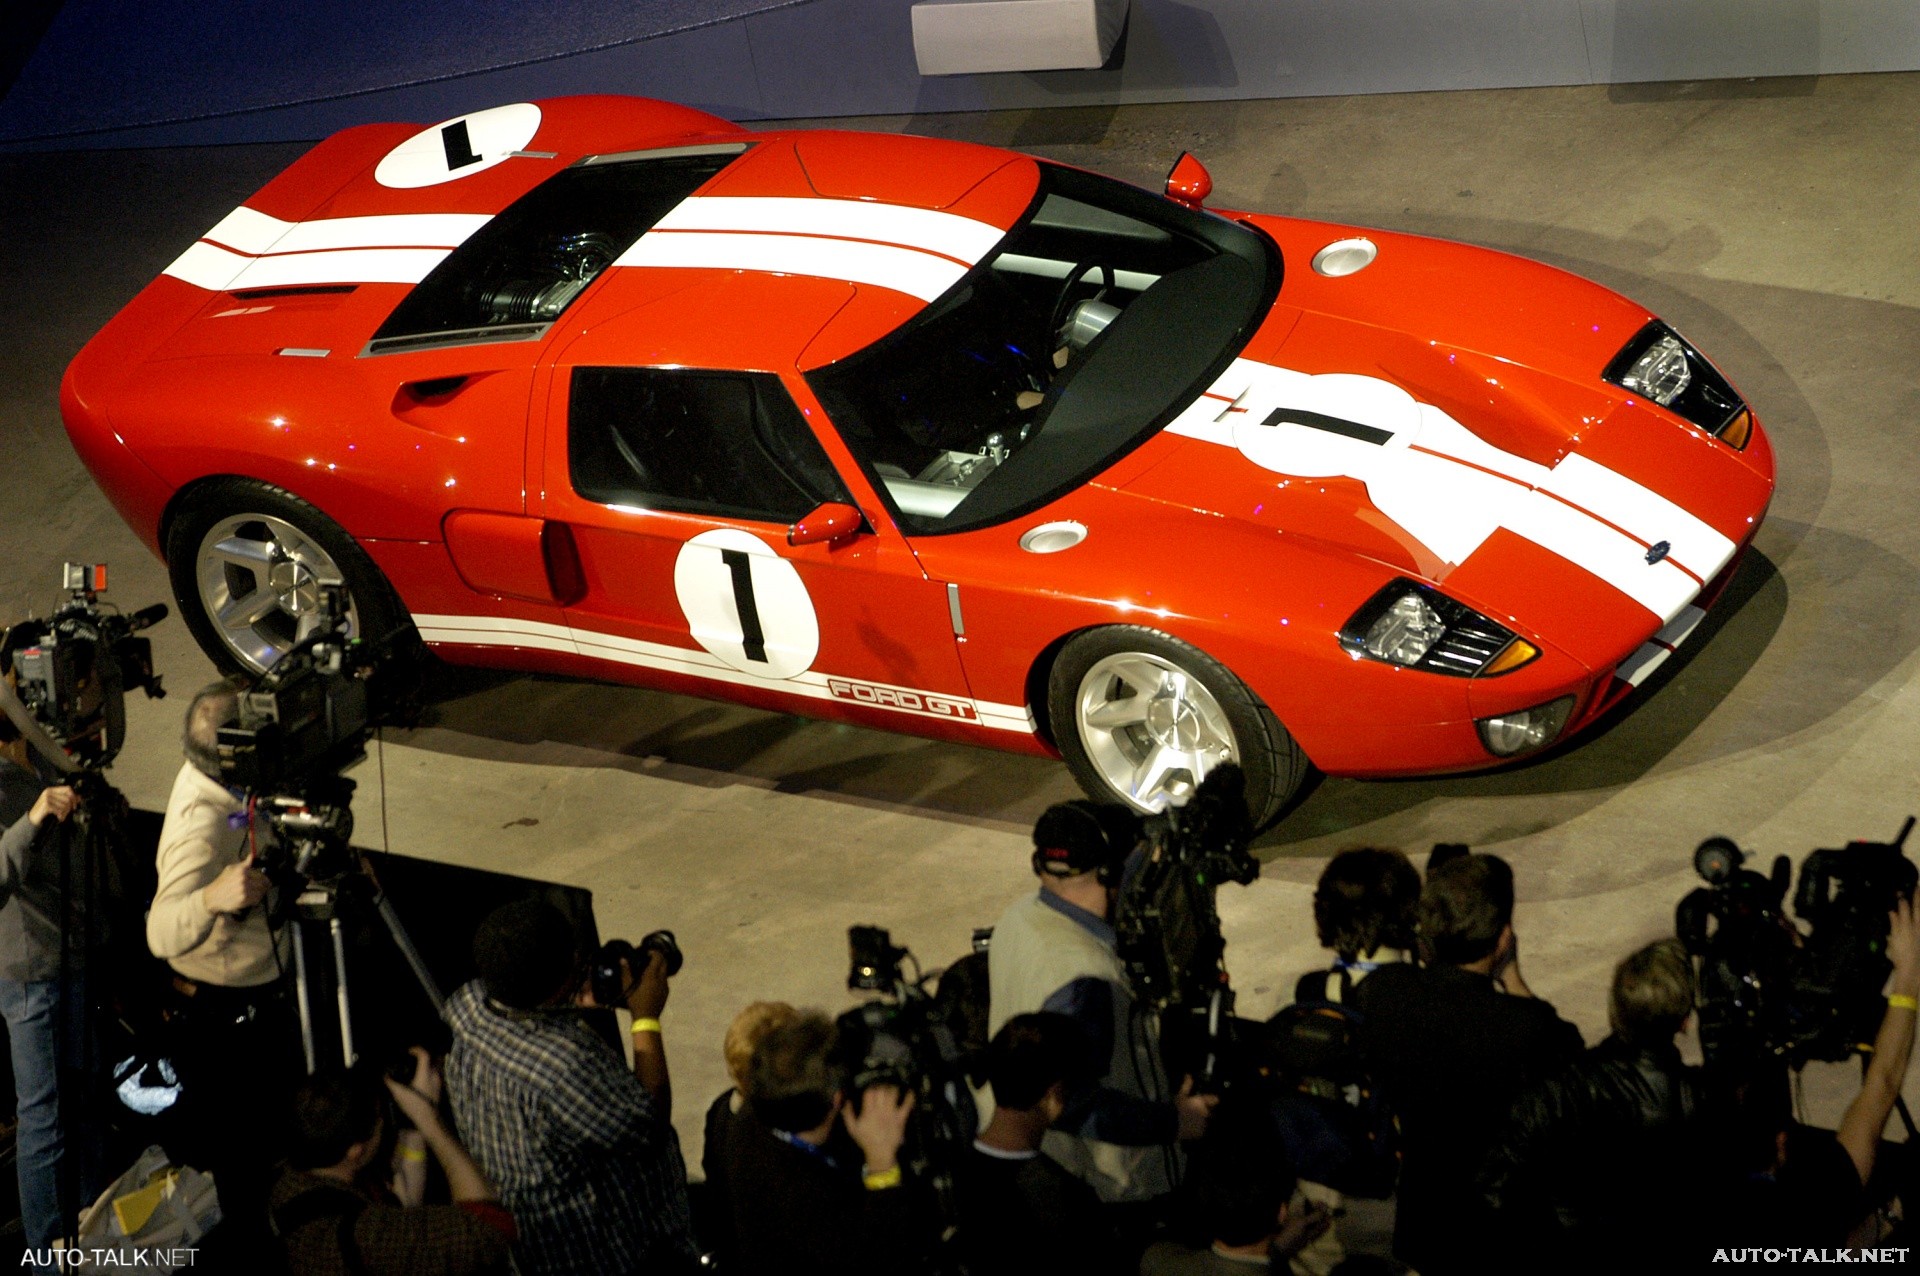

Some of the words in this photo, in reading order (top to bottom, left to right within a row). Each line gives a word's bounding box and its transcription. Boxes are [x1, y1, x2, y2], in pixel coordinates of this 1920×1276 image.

[441, 119, 483, 171] 1
[1260, 407, 1395, 446] 1
[721, 548, 768, 663] 1
[829, 680, 923, 710] FORD
[926, 696, 971, 718] GT
